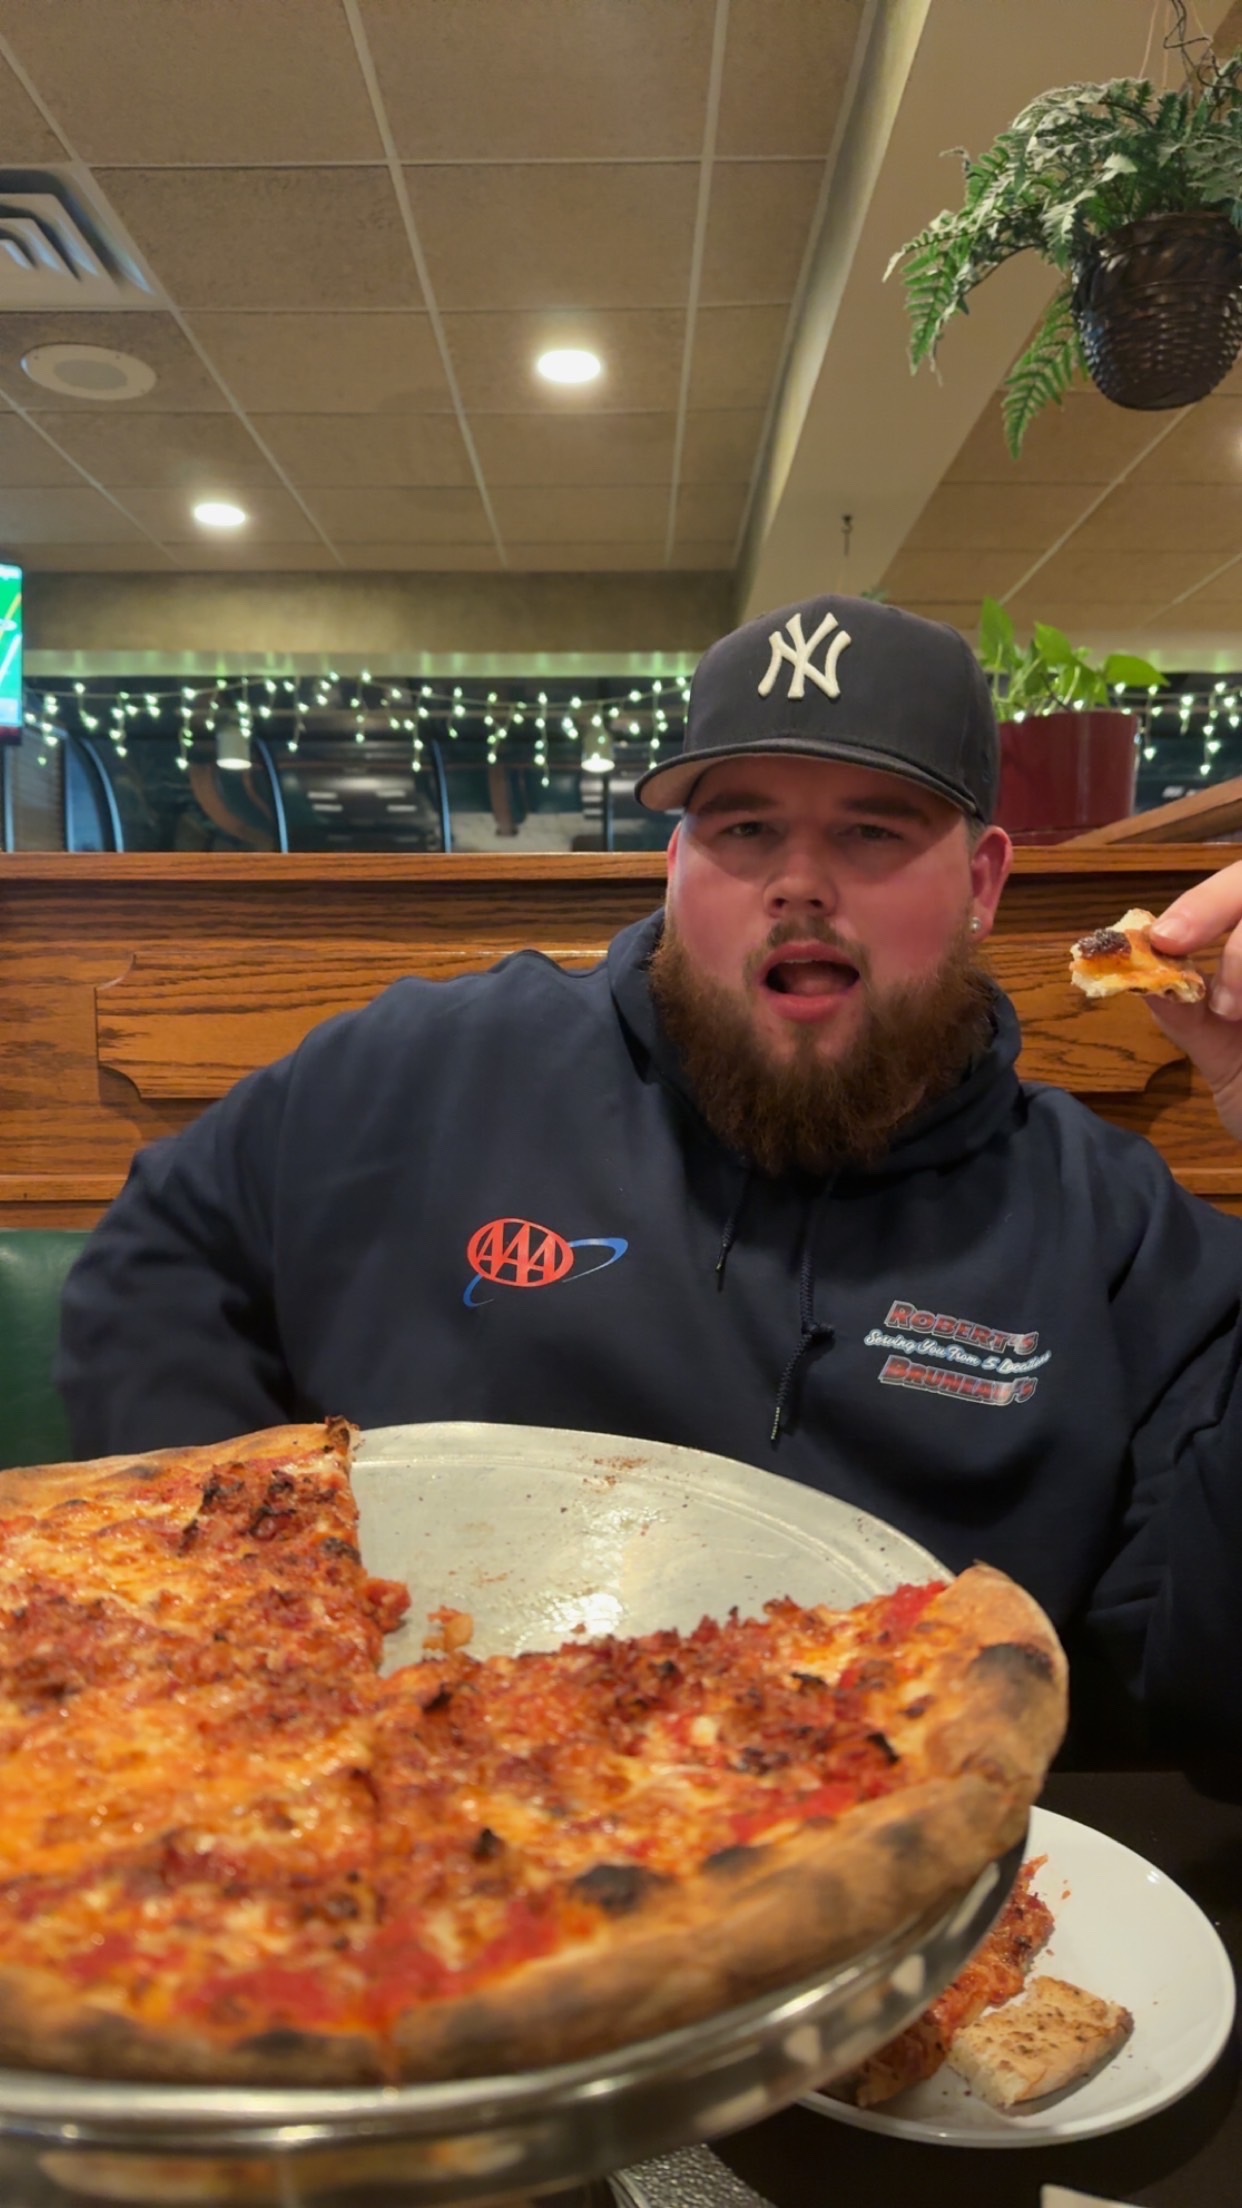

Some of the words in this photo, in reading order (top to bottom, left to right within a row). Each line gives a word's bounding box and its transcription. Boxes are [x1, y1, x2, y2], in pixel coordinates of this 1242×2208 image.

[758, 612, 852, 698] NY
[471, 1219, 568, 1287] AAA
[864, 1328, 916, 1354] Serving
[916, 1338, 946, 1358] You
[946, 1344, 980, 1367] From
[981, 1355, 1000, 1370] 5
[884, 1300, 1039, 1355] ROBERT'S
